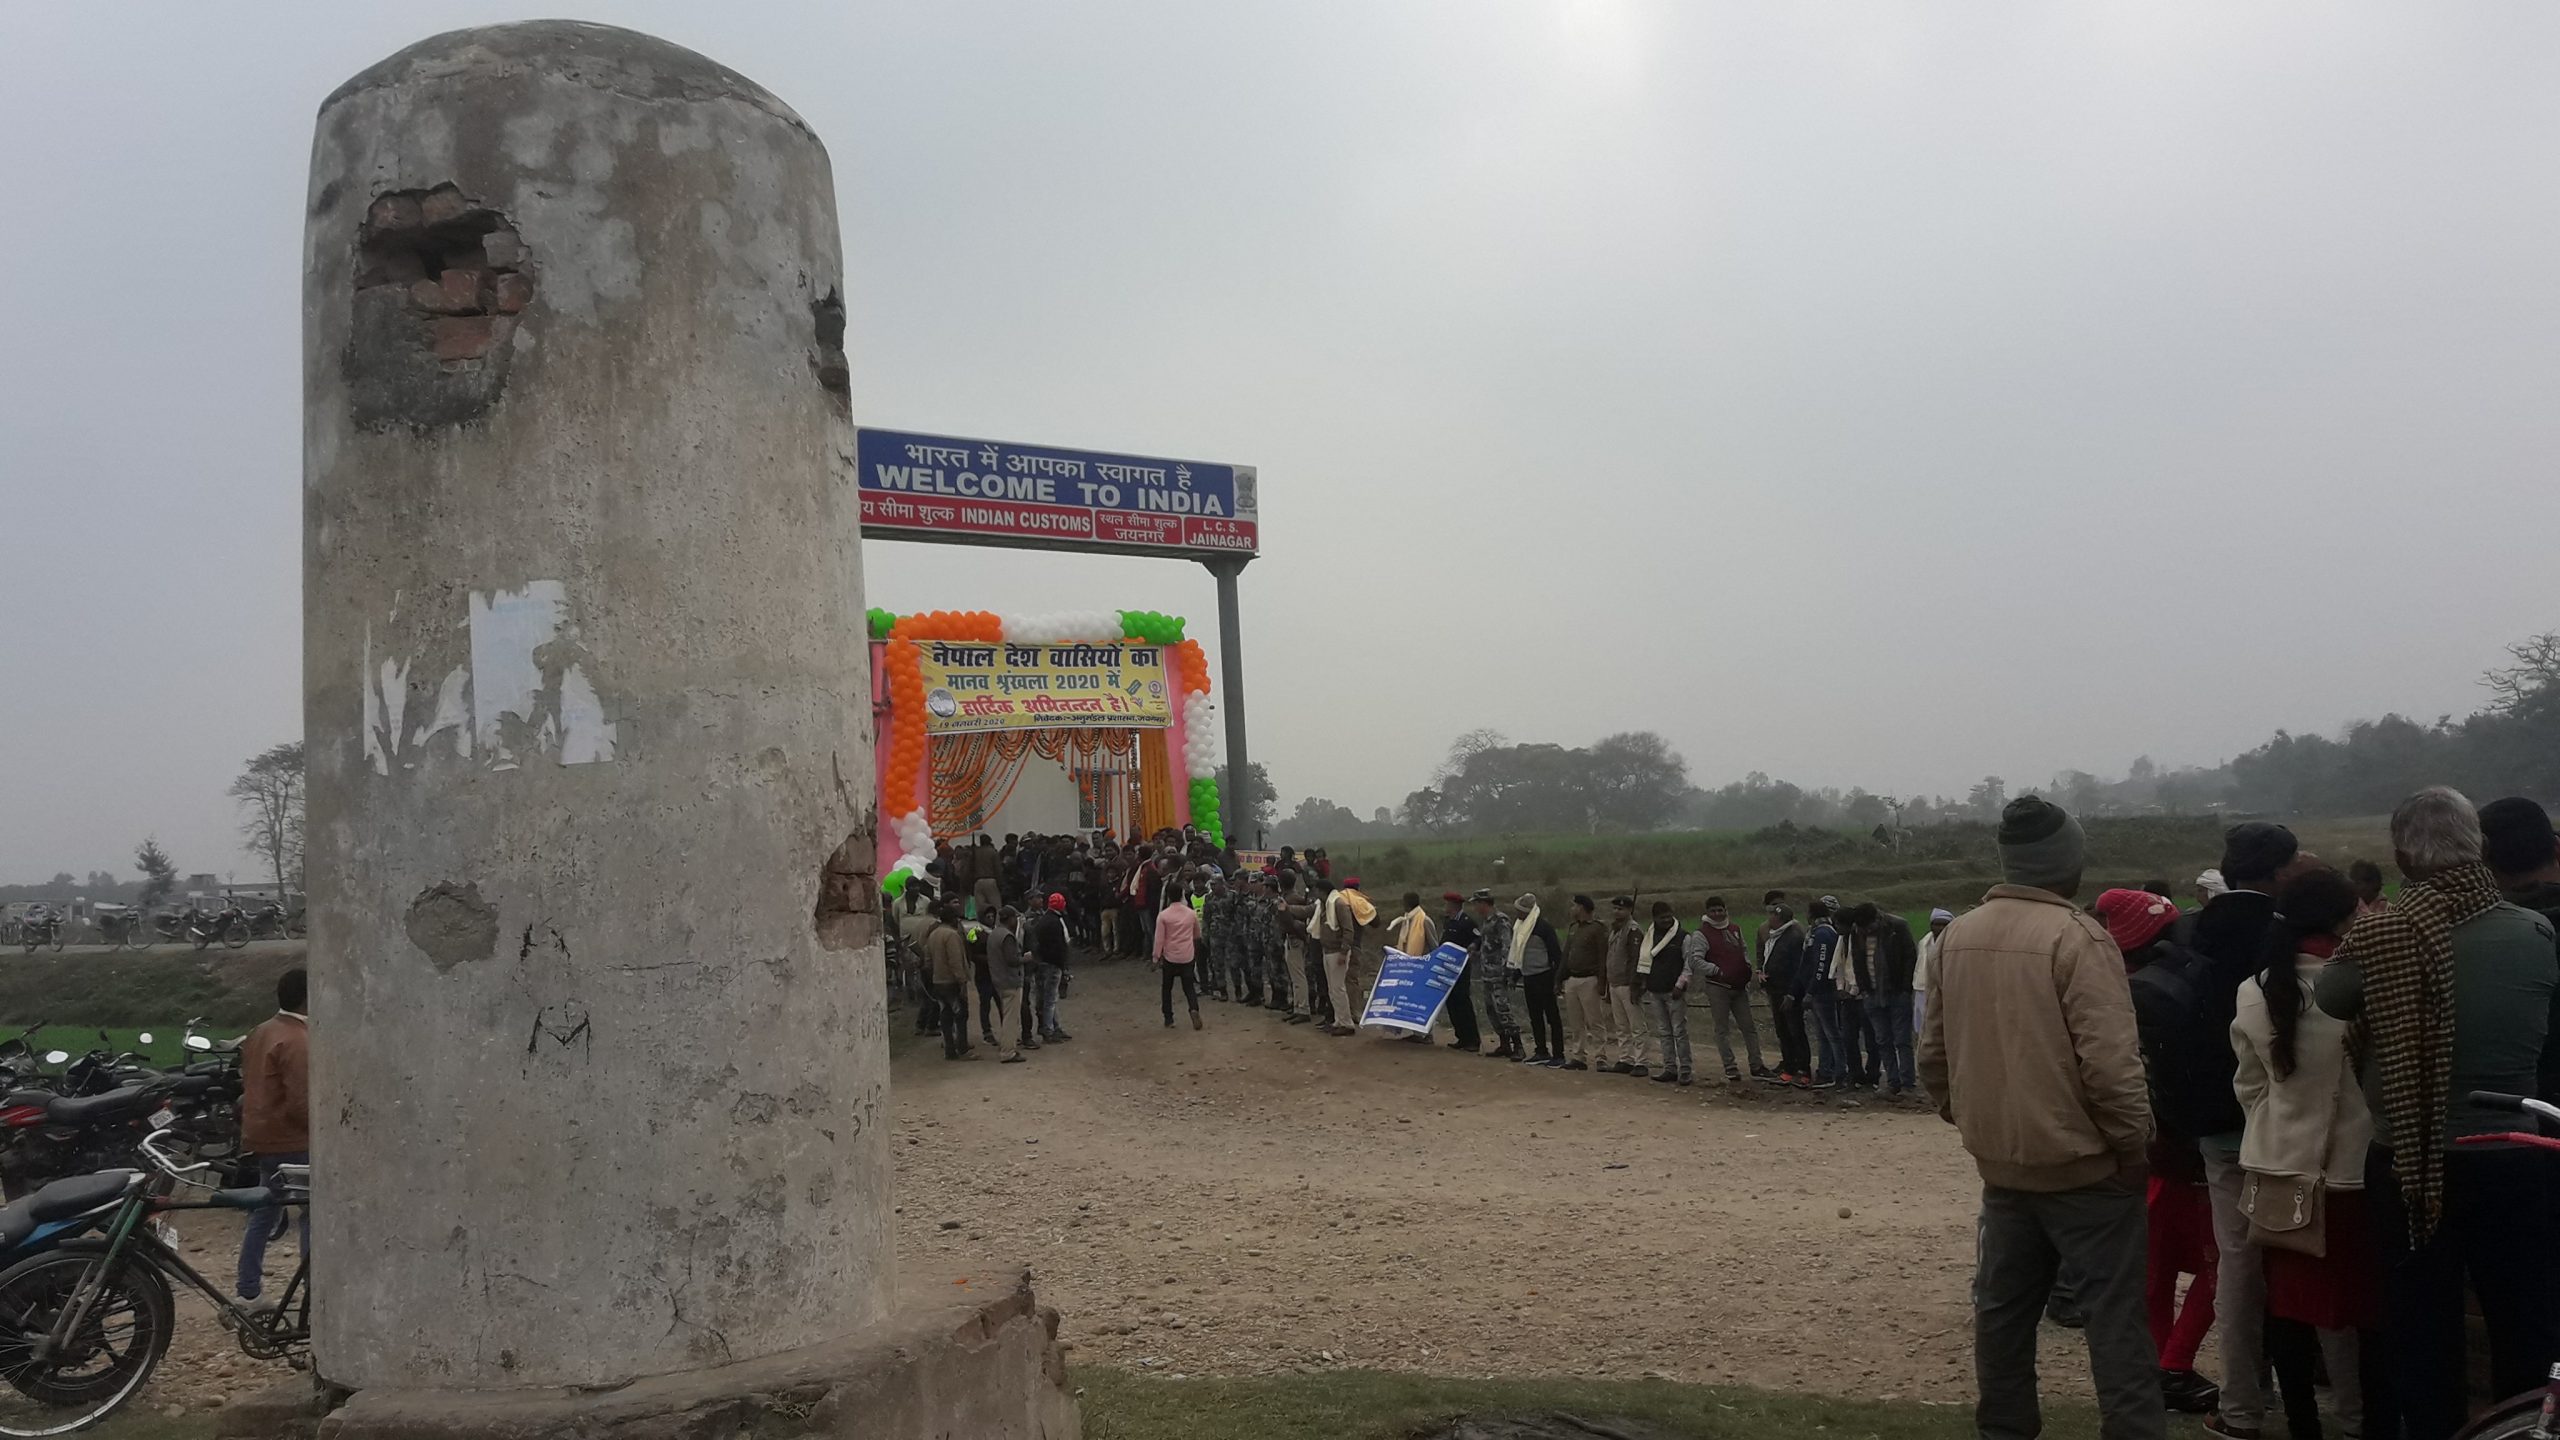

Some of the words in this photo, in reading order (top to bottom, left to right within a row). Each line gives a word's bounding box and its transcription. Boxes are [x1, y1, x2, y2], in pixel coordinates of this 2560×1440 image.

[905, 443, 969, 468] भारत
[978, 444, 999, 471] में
[1005, 454, 1086, 478] आपका
[1095, 462, 1165, 486] स्वागत
[1176, 464, 1192, 490] है
[876, 464, 1056, 501] WELCOME
[1078, 482, 1121, 507] TO
[1138, 488, 1224, 515] INDIA
[878, 498, 913, 518] सीमा
[918, 505, 955, 525] शुल्क
[962, 507, 1014, 526] INDIAN
[1020, 511, 1091, 532] CUSTOMS
[1100, 513, 1124, 526] स्थल
[1127, 513, 1150, 527] सीमा
[1154, 517, 1178, 530] शुल्क
[1114, 528, 1165, 543] जयनगर
[1190, 533, 1252, 549] JAINAGAR
[932, 641, 997, 667] नेपाल
[1005, 643, 1042, 667] देश
[1049, 643, 1124, 667] वासियों
[1129, 648, 1158, 667] का
[945, 674, 990, 690] मानव
[1055, 674, 1100, 689] 2020
[1106, 670, 1121, 688] में
[958, 694, 1015, 716] हार्दिक
[984, 718, 1005, 726] 2020
